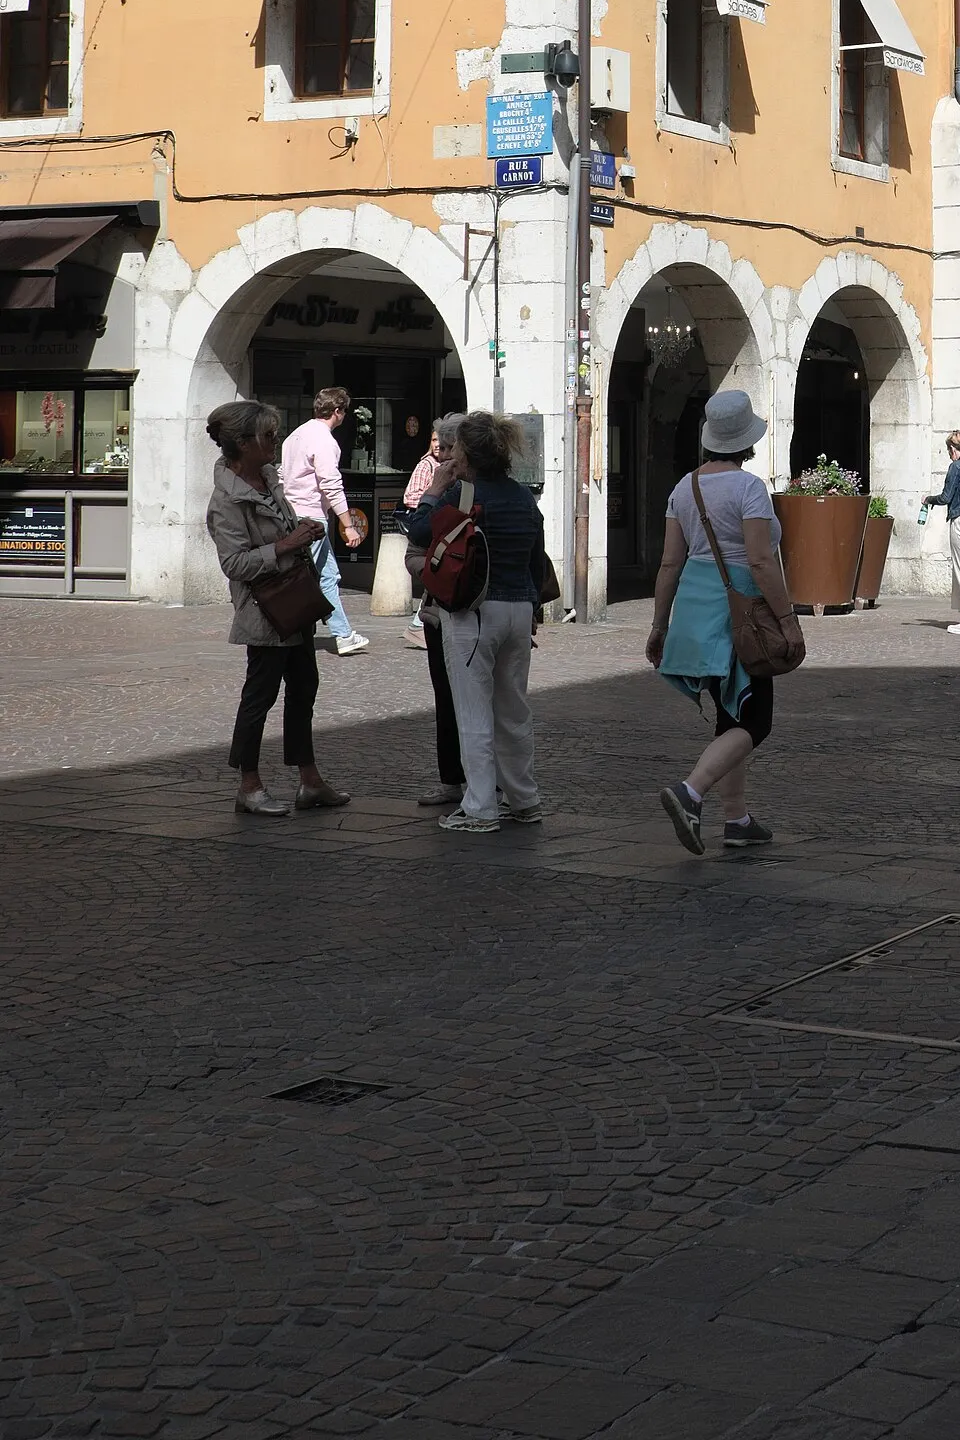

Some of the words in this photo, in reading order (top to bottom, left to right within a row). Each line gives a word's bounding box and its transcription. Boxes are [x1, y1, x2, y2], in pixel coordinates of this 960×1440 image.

[885, 52, 923, 73] Sandwiches
[506, 101, 532, 109] ANNECY
[492, 126, 529, 134] CRUSEILLES
[504, 134, 526, 142] JULIEN
[593, 154, 607, 165] RUE
[508, 160, 528, 170] RUE
[502, 171, 534, 182] CARNOT
